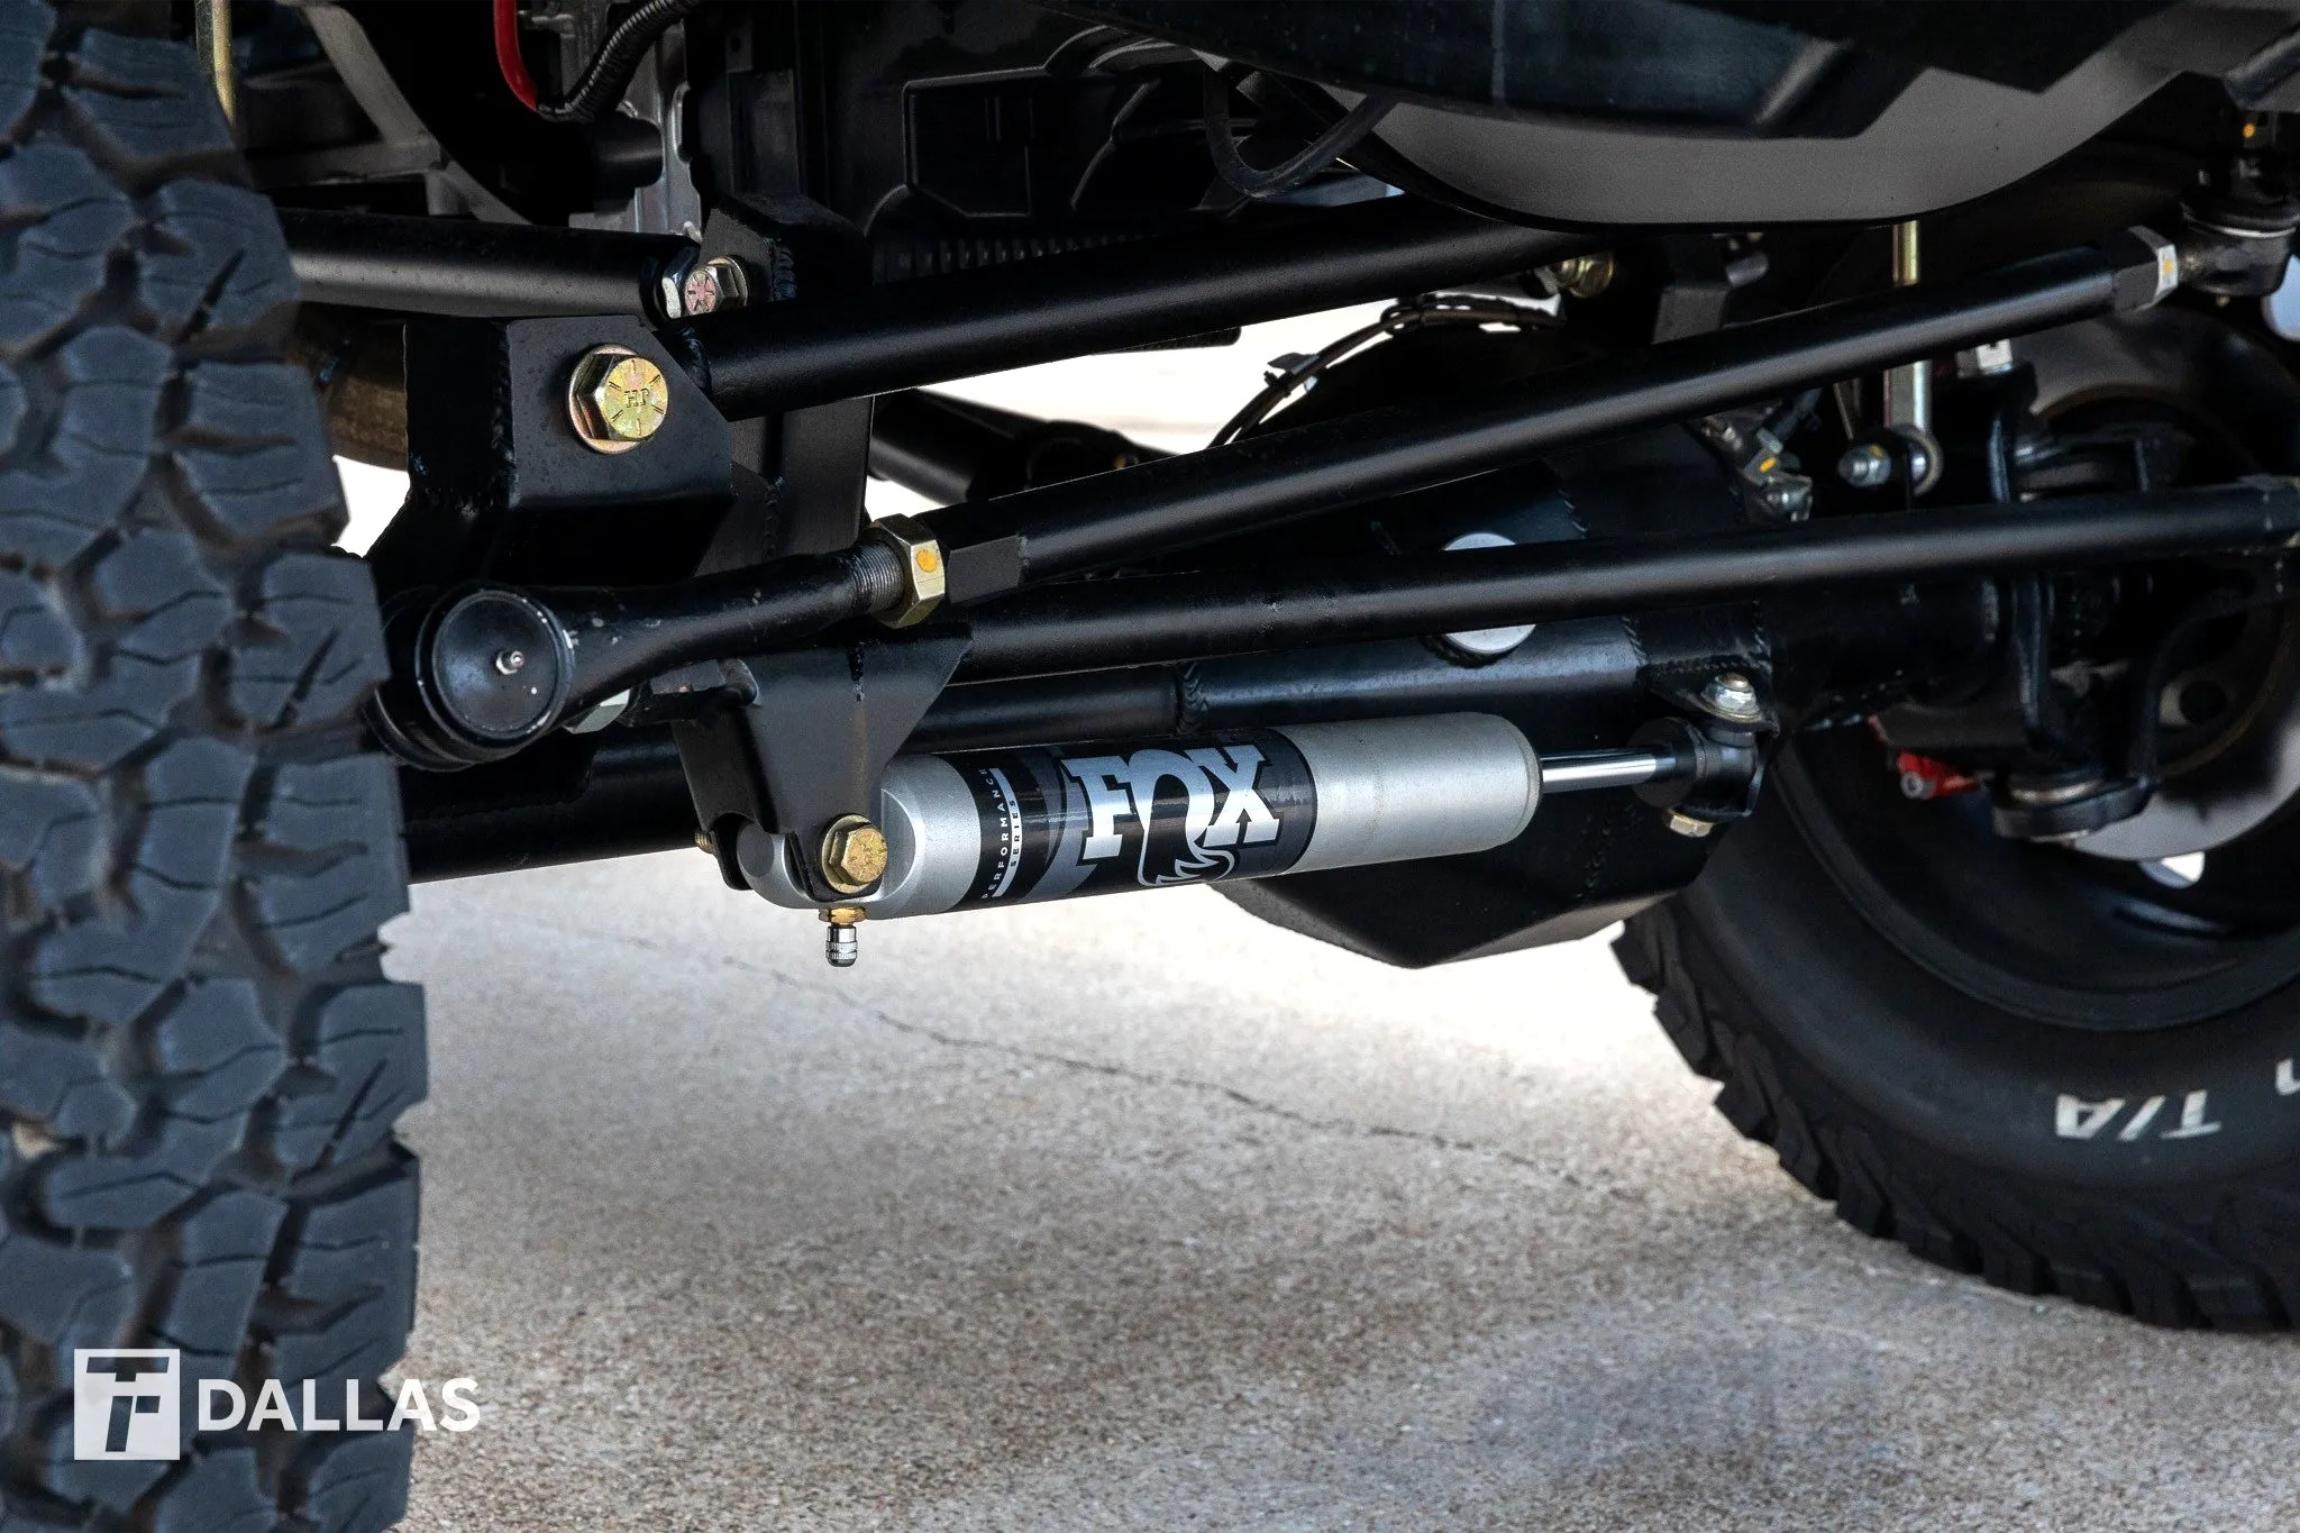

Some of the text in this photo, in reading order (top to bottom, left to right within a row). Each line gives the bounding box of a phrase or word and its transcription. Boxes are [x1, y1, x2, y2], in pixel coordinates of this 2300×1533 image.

[979, 767, 1009, 899] PERFORMANCE
[1009, 800, 1021, 868] SERIES
[1060, 744, 1280, 886] FOX
[2055, 1089, 2222, 1141] T/A
